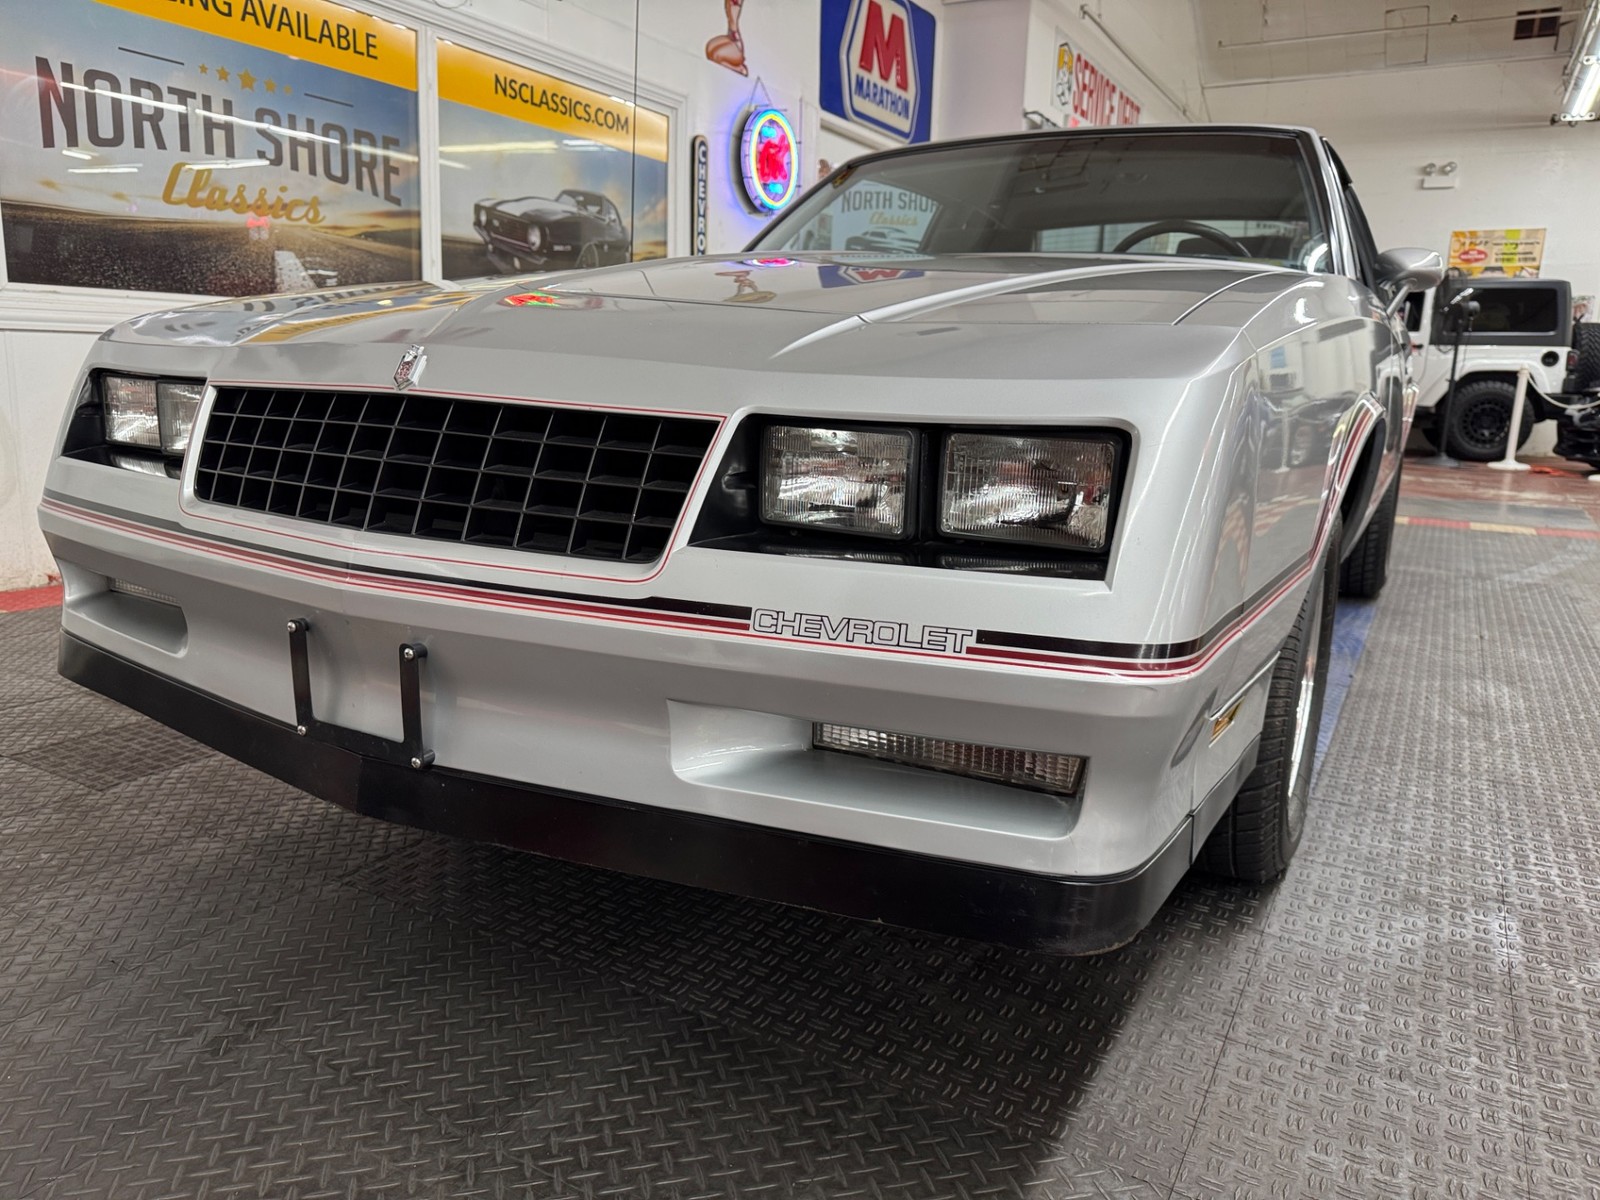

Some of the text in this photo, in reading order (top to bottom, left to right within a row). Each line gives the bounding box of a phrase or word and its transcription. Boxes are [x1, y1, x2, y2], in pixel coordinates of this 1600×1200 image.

[240, 0, 378, 59] AVAILABLE
[494, 73, 629, 134] NSCLASSICS.COM
[854, 73, 910, 120] MARATHON
[1073, 53, 1117, 126] SERVICE
[35, 56, 402, 207] NORTH SHORE
[162, 162, 326, 225] Classics
[697, 143, 707, 255] CHEVRO
[841, 190, 893, 213] NORTH
[752, 608, 973, 653] CHEVROLET
